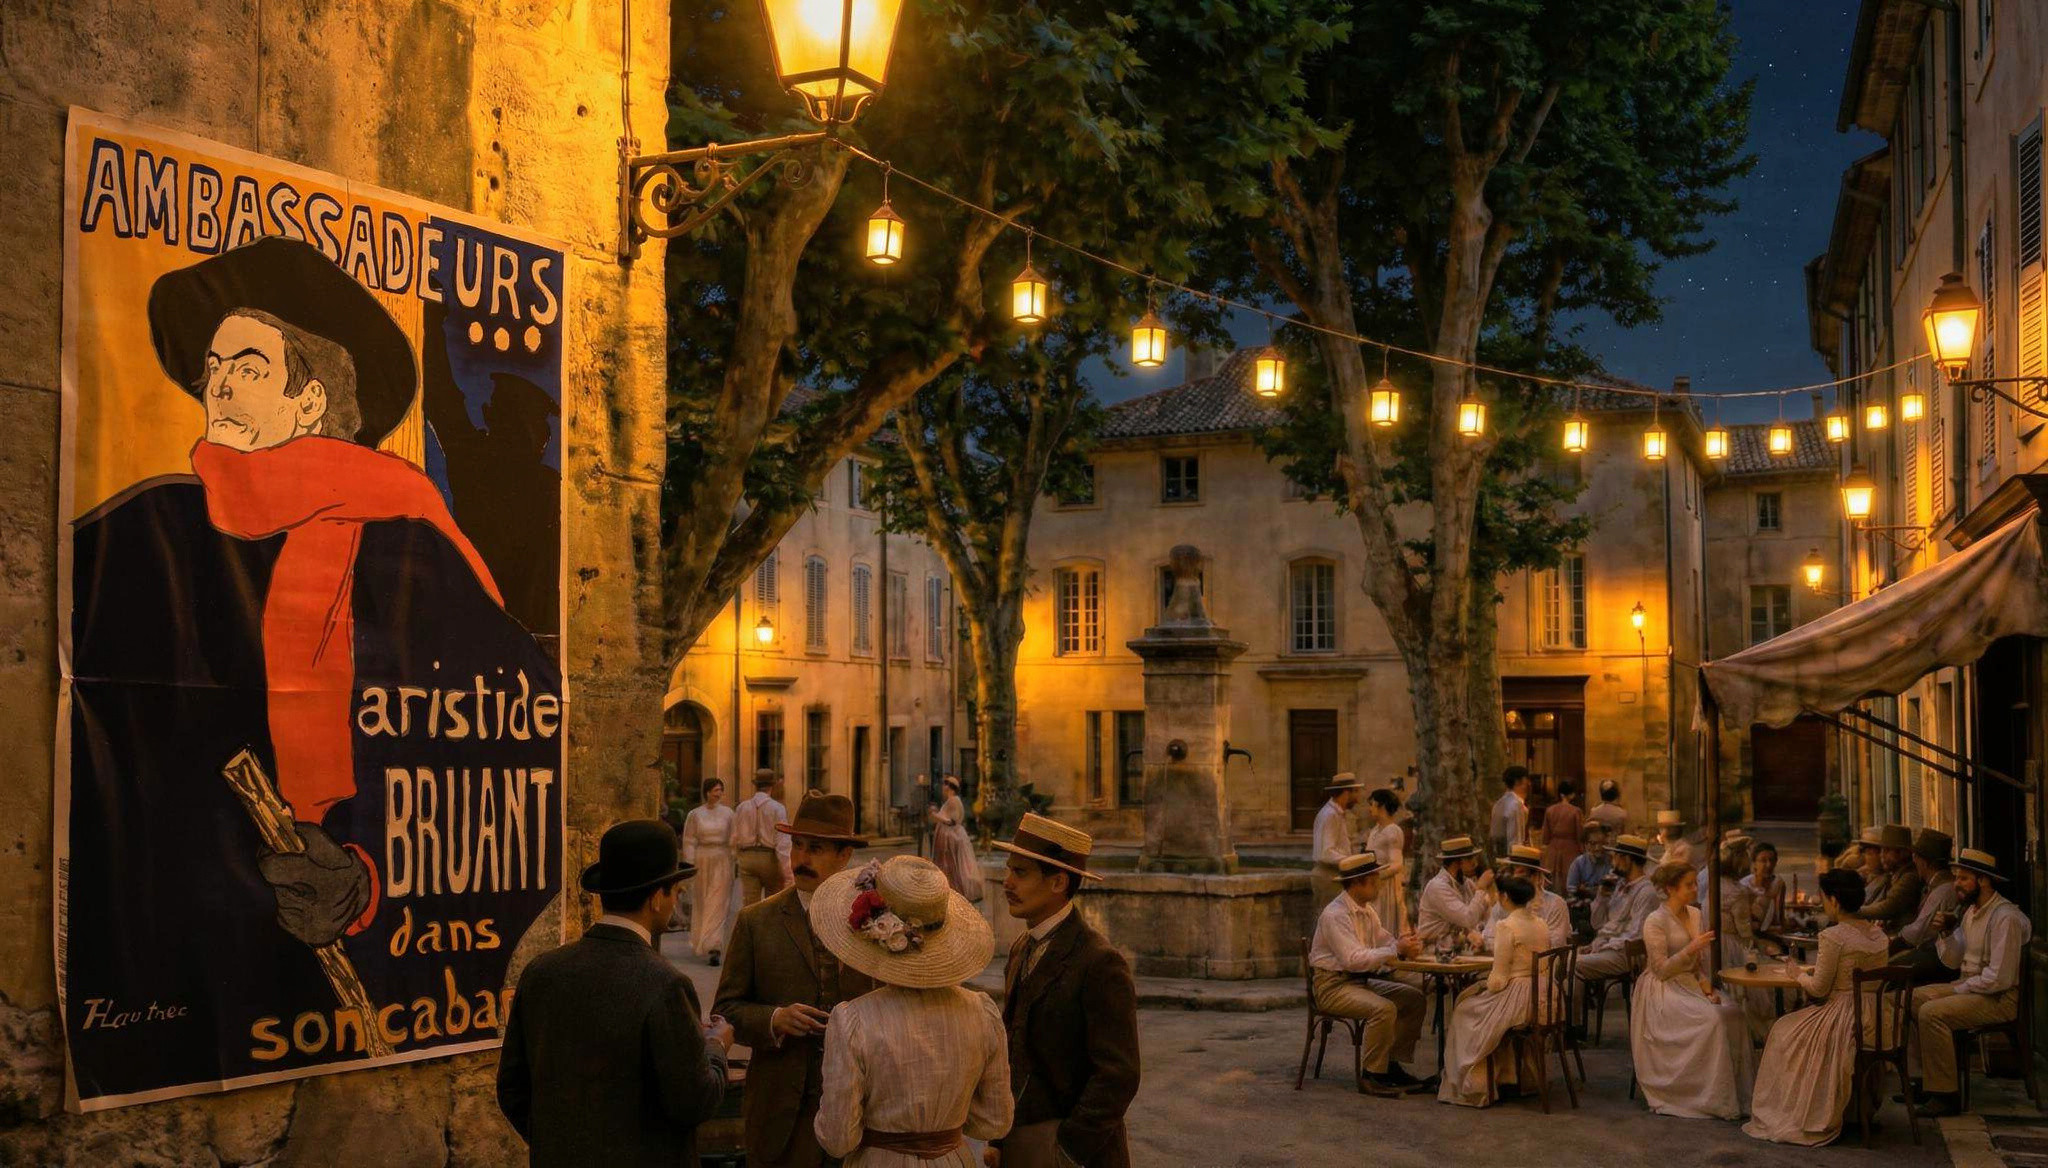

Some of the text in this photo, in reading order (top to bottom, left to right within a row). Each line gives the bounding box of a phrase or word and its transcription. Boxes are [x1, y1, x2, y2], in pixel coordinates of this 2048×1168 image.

[80, 138, 563, 326] AMBASSADEURS
[357, 660, 560, 740] aristide
[384, 766, 555, 898] BRUANT
[389, 904, 501, 958] dans
